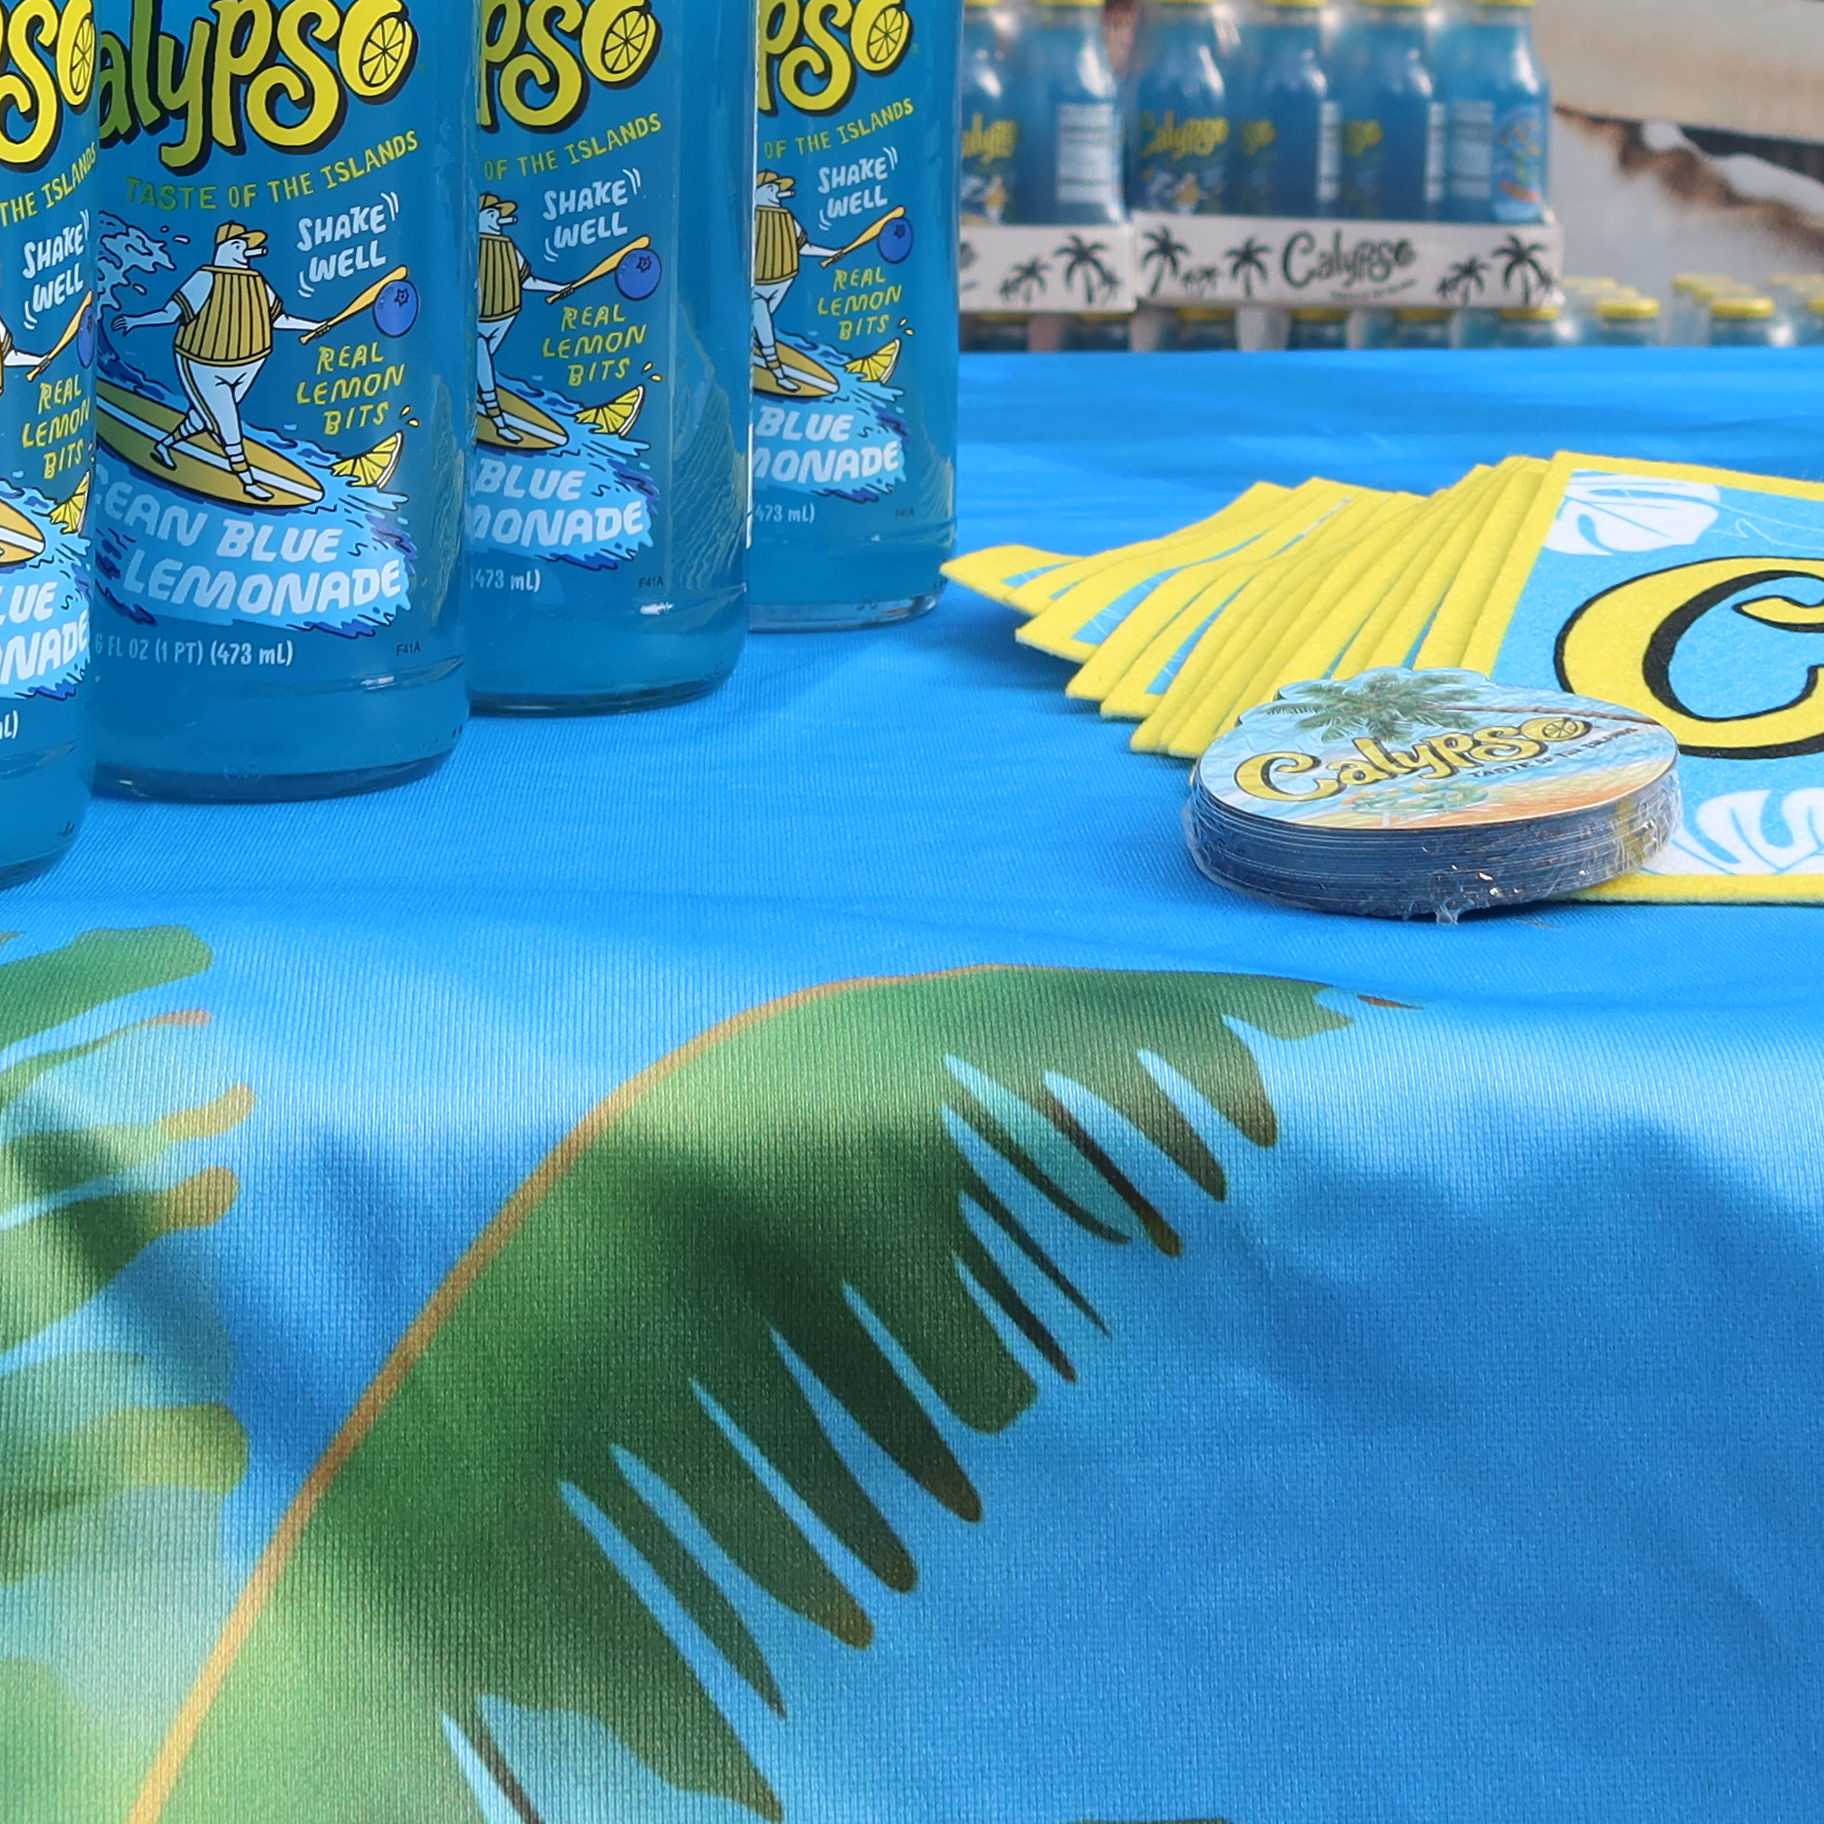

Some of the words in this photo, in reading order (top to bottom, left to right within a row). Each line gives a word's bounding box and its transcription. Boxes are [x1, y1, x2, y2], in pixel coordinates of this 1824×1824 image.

[484, 159, 508, 181] OF
[516, 151, 559, 177] THE
[568, 113, 663, 166] ISLANDS
[763, 139, 788, 161] OF
[794, 130, 831, 156] THE
[839, 98, 914, 146] ISLANDS
[44, 142, 97, 209] ISLANDS
[126, 175, 218, 212] TASTE
[228, 182, 257, 208] OF
[267, 171, 314, 204] THE
[320, 130, 420, 190] ISLANDS
[817, 155, 888, 195] SHAKE
[542, 179, 630, 222] SHAKE
[826, 185, 888, 221] WELL
[297, 203, 388, 253] SHAKE
[553, 210, 629, 251] WELL
[23, 226, 85, 280] SHAKE
[309, 240, 387, 284] WELL
[1281, 228, 1418, 289] Calypso
[33, 275, 85, 314] WELL
[817, 284, 904, 316] LEMON
[832, 267, 887, 292] REAL
[560, 303, 626, 332] REAL
[838, 314, 891, 342] BITS
[315, 342, 384, 375] REAL
[542, 324, 647, 360] LEMON
[295, 362, 406, 406] LEMON
[567, 358, 630, 387] BITS
[39, 374, 82, 415] REAL
[22, 398, 89, 449] LEMON
[323, 401, 390, 436] BITS
[755, 405, 855, 443] BLUE
[43, 440, 84, 480] BITS
[476, 456, 587, 502] BLUE
[787, 503, 816, 525] mL)
[216, 517, 343, 564] BLUE
[119, 549, 402, 617] LEMONADE
[510, 567, 541, 593] mL)
[107, 635, 124, 657] FL
[128, 637, 150, 661] OZ
[174, 639, 204, 666] PT)
[210, 639, 252, 667] (473
[258, 639, 294, 667] mL)
[1231, 714, 1594, 803] Calypso
